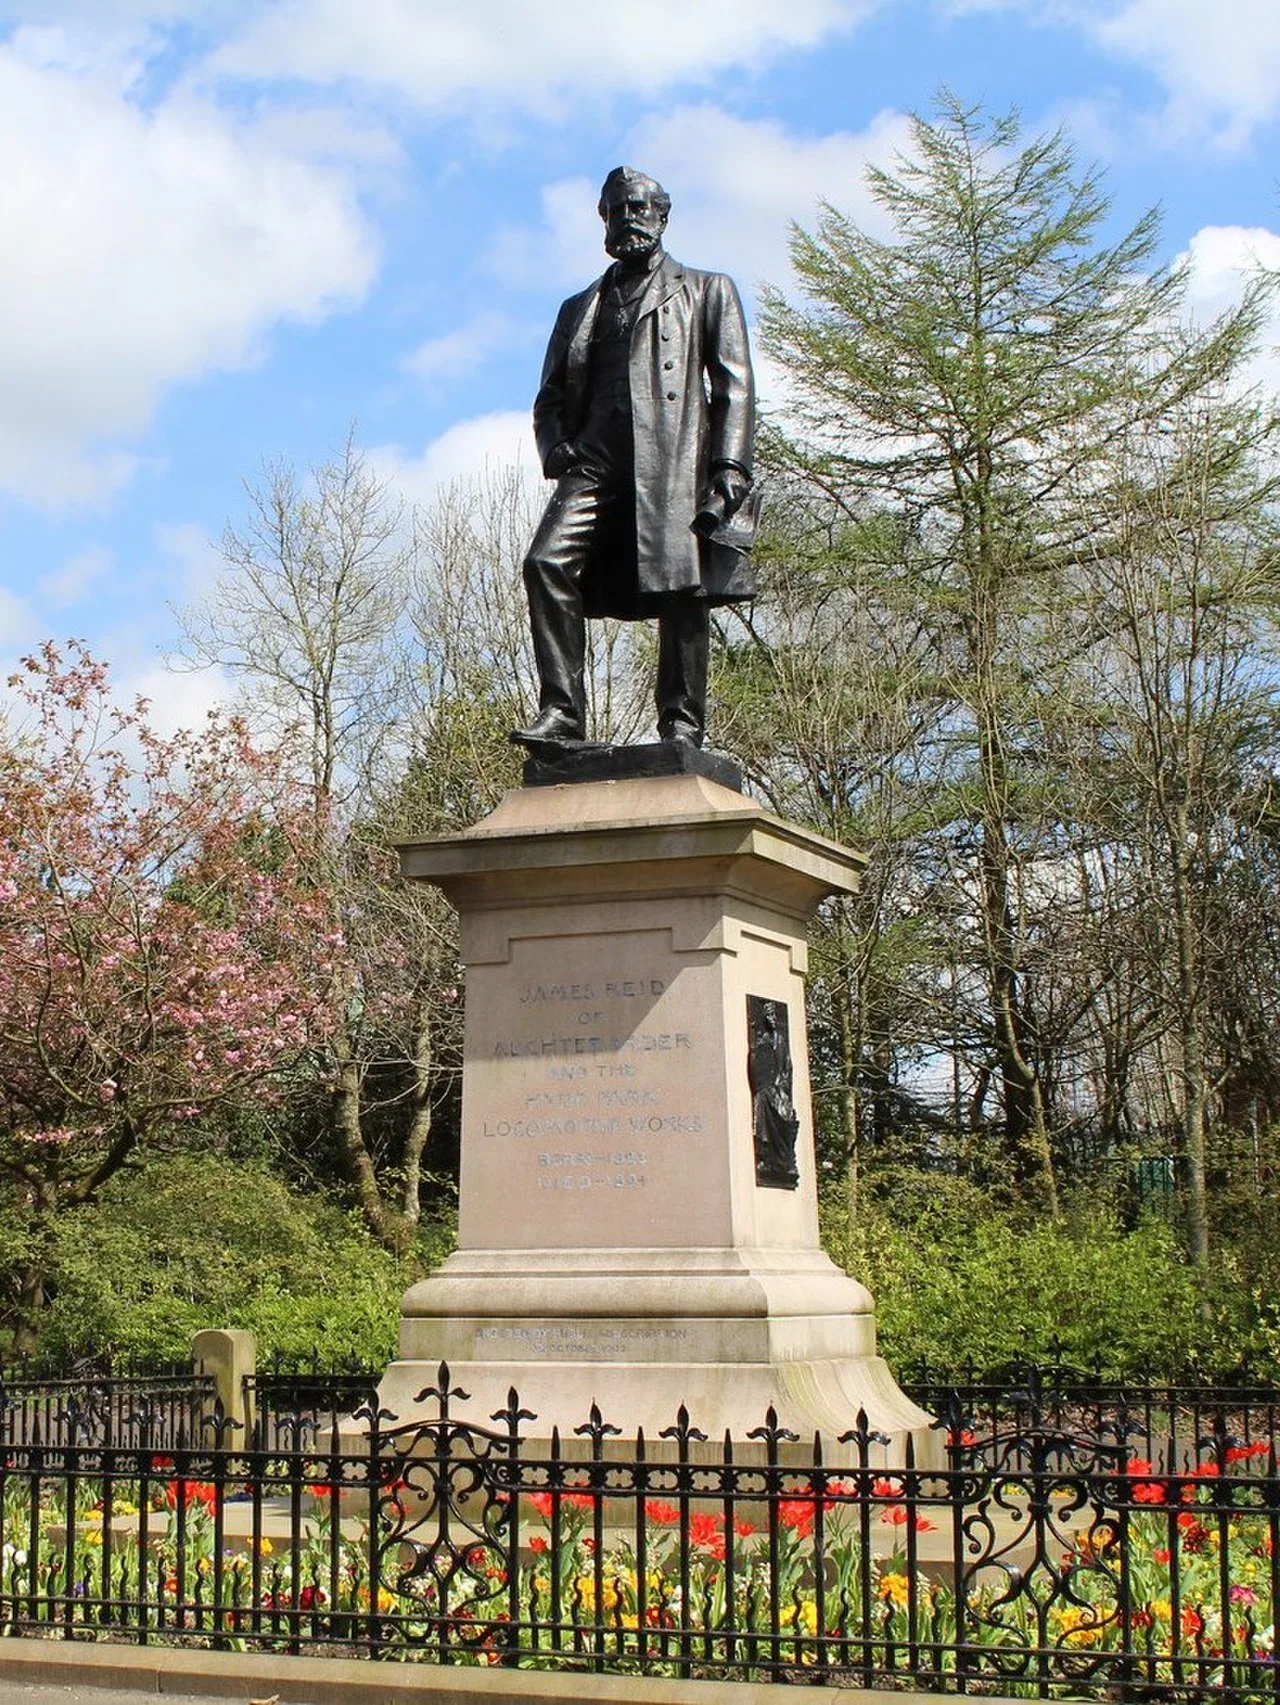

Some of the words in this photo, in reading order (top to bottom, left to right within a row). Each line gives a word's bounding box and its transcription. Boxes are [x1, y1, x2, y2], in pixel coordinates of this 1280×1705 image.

[520, 981, 595, 1003] JAMES
[605, 979, 664, 997] REID
[577, 1010, 604, 1025] OF
[549, 1065, 588, 1080] AND
[596, 1063, 635, 1078] THE
[628, 1114, 703, 1134] WORKS
